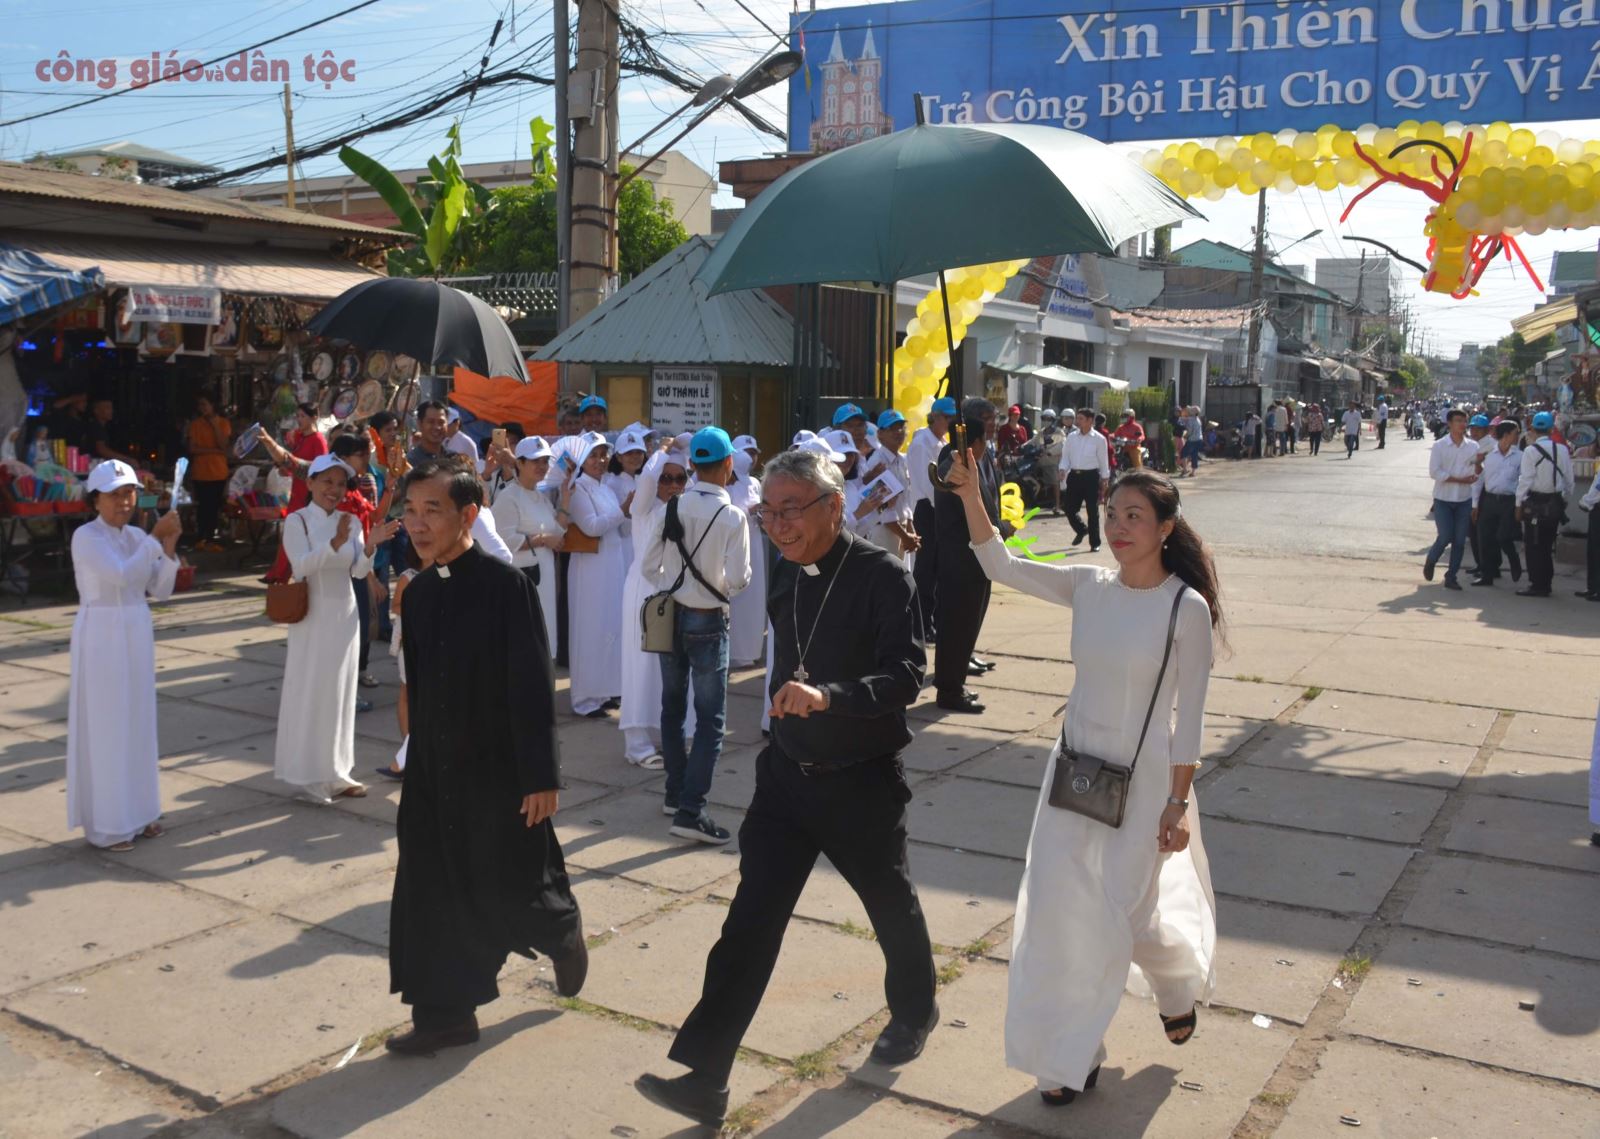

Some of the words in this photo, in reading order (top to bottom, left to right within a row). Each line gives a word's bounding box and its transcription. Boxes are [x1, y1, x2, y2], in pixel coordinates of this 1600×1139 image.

[1055, 12, 1162, 64] Xin
[919, 91, 975, 125] Trả
[985, 87, 1088, 130] Công
[1098, 79, 1167, 123] Bội
[1177, 74, 1267, 118] Hậu
[1280, 69, 1372, 107] Cho
[1385, 58, 1491, 110] Quý
[1503, 54, 1564, 101] Vị
[672, 385, 699, 399] THÁNH
